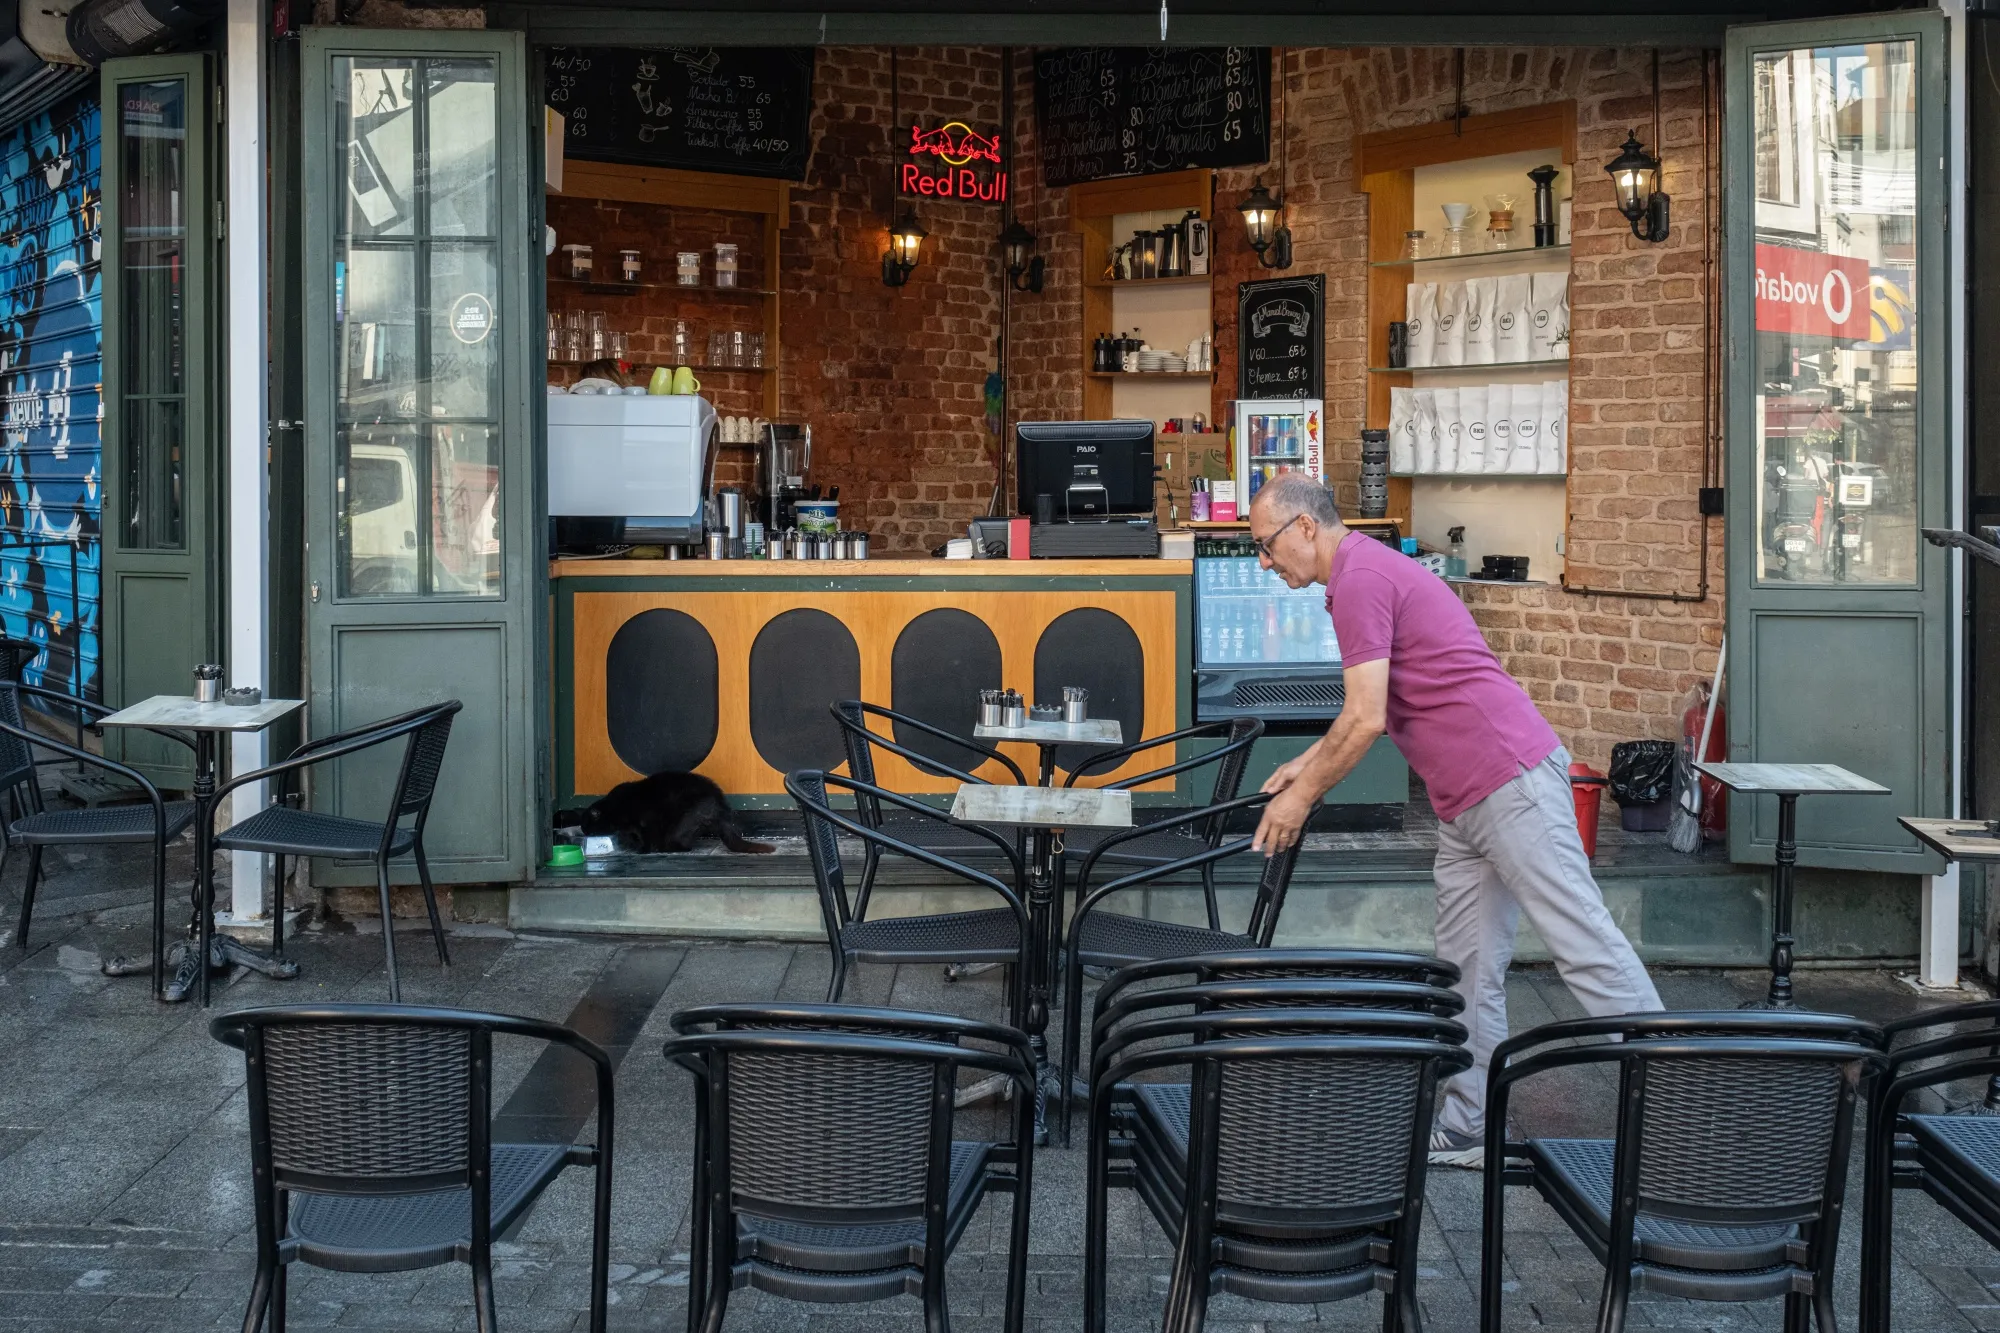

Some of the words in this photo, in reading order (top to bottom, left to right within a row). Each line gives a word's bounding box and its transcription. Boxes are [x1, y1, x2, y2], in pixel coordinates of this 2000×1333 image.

[551, 56, 591, 72] 46/50
[1227, 47, 1241, 66] 65
[560, 75, 576, 87] 55
[738, 75, 756, 89] 55
[1100, 68, 1115, 87] 65
[1226, 67, 1241, 87] 65
[550, 88, 569, 102] 60
[756, 92, 771, 104] 65
[1101, 88, 1116, 107] 75
[1227, 91, 1242, 112] 80
[573, 107, 588, 120] 60
[685, 101, 739, 119] Americano
[747, 108, 762, 119] 55
[1130, 107, 1143, 126] 80
[572, 122, 588, 137] 63
[748, 120, 763, 131] 50
[1224, 119, 1241, 142] 65
[753, 138, 789, 153] 40/50
[1122, 128, 1135, 148] 80
[1123, 152, 1137, 171] 75
[903, 163, 953, 196] Red
[959, 169, 1007, 202] Bull
[1249, 347, 1266, 361] V60
[1248, 366, 1281, 385] Chemex
[1308, 444, 1319, 464] Bull
[1308, 466, 1319, 480] ed
